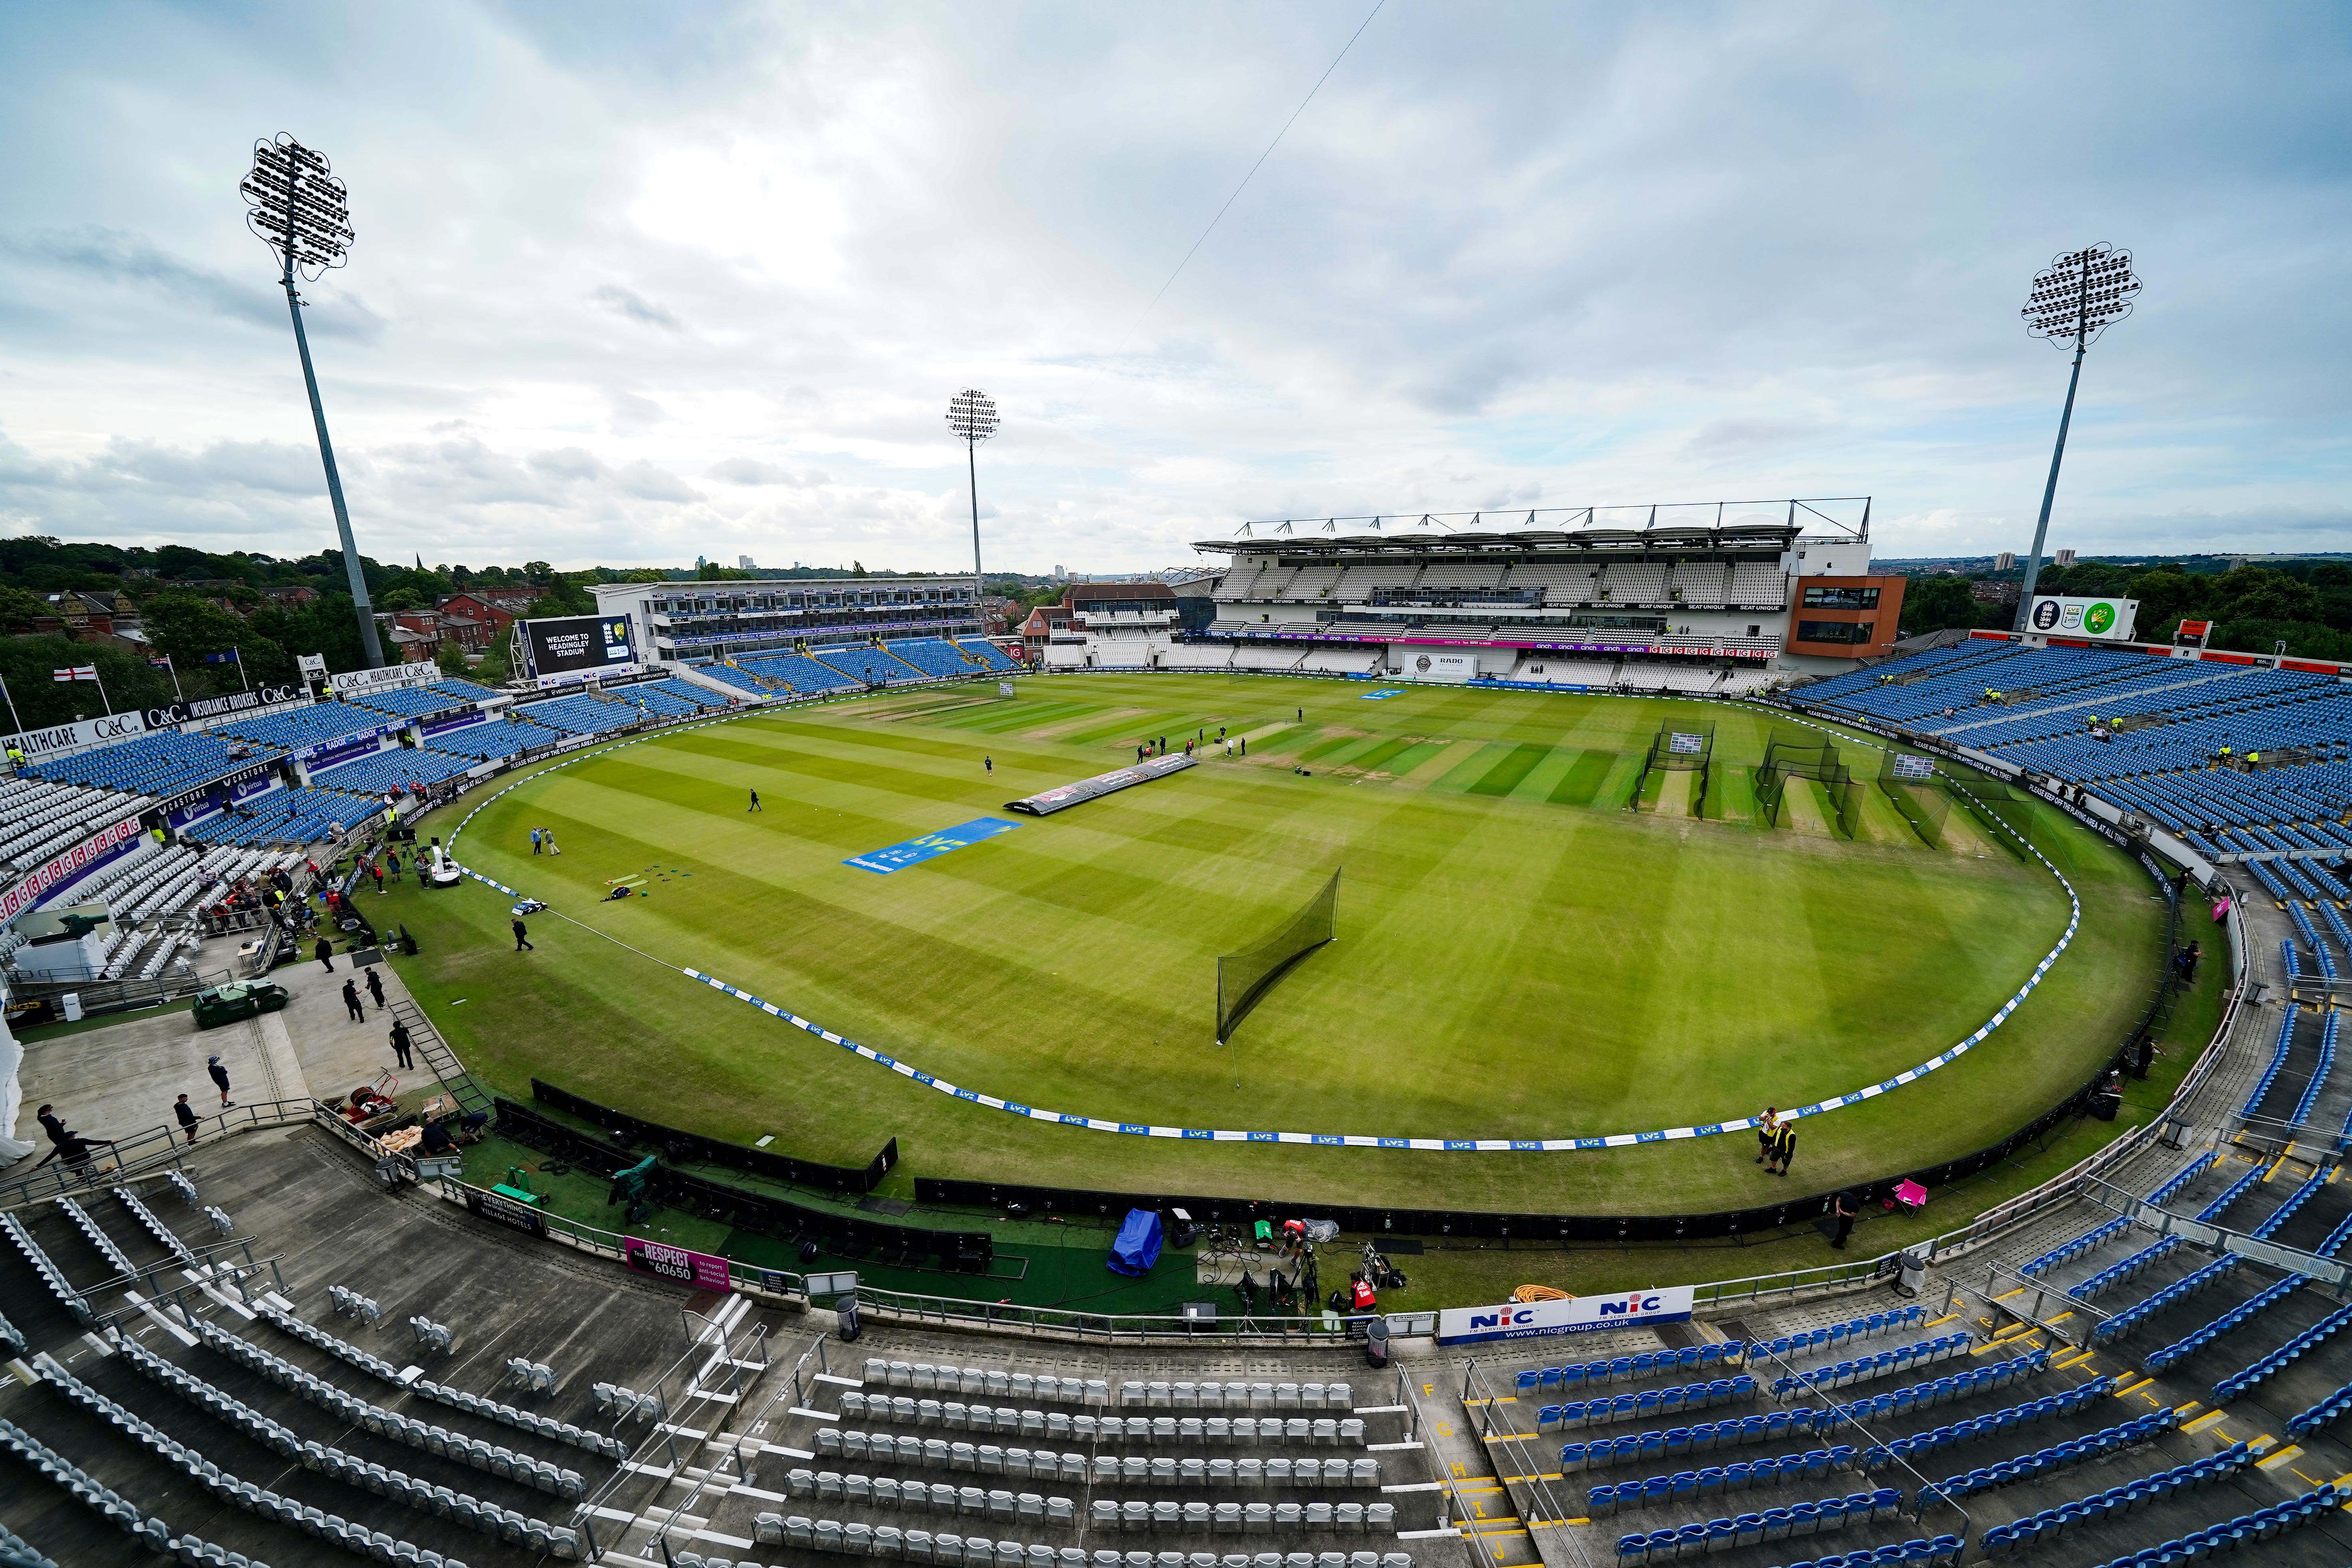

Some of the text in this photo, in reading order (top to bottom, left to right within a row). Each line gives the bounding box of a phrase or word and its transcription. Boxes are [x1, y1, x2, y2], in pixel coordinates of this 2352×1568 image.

[546, 634, 579, 643] WELCOME
[549, 640, 589, 651] HEADINGLEY
[557, 648, 585, 657] STADIUM
[369, 668, 403, 683] HEALTHCARE
[405, 664, 428, 678] C&C
[338, 673, 365, 688] C&C
[262, 685, 292, 704] C&C
[190, 692, 258, 718] INSURANCE BROKERS
[148, 706, 183, 727] C&C
[95, 716, 133, 738] C&C
[387, 721, 407, 732] RADOX
[1847, 720, 1862, 728] PLAYING
[1887, 731, 1898, 739] TIMES
[357, 729, 377, 741] RADOX
[326, 737, 347, 750] RADOX
[510, 759, 527, 769] PLEASE
[527, 755, 539, 763] KEEP
[540, 751, 551, 760] OFF
[550, 749, 560, 757] THE
[560, 743, 580, 753] PLAYING
[581, 739, 594, 748] AREA
[609, 732, 622, 741] TIMES
[294, 747, 314, 761] RADOX
[233, 764, 268, 783] CASTORE
[246, 780, 262, 790] virtua
[169, 788, 206, 811] CASTORE
[193, 801, 210, 813] virtua
[2029, 784, 2044, 796] PLEASE
[2044, 791, 2055, 801] KEEP
[2055, 797, 2063, 806] OFF
[2070, 806, 2086, 822] PLAYING
[2086, 817, 2098, 829] AREA
[2098, 824, 2106, 833] AT
[2104, 828, 2114, 839] ALL
[2114, 833, 2128, 846] TIMES
[117, 824, 128, 838] IG
[129, 819, 138, 832] IG
[96, 835, 107, 851] IG
[108, 830, 115, 844] IG
[125, 836, 136, 845] virtua
[51, 847, 115, 888] OFFICIAL METAVERSE PARTNER
[483, 1194, 523, 1213] EVERYTHING
[481, 1207, 506, 1221] VILLAGE
[508, 1216, 531, 1230] HOTELS
[645, 1244, 688, 1268] RESPECT
[655, 1263, 690, 1280] 60650
[699, 1269, 725, 1278] anti-social
[700, 1275, 725, 1285] behaviour
[1951, 1298, 1966, 1308] F
[1505, 1319, 1630, 1338] www.nicgroup.co.uk
[1978, 1317, 1993, 1328] G
[2025, 1338, 2045, 1349] H
[2078, 1363, 2099, 1376] I
[1423, 1384, 1434, 1397] F
[1438, 1423, 1452, 1437] G
[1450, 1462, 1467, 1477] H
[1472, 1501, 1486, 1517] I
[1493, 1541, 1505, 1559] J
